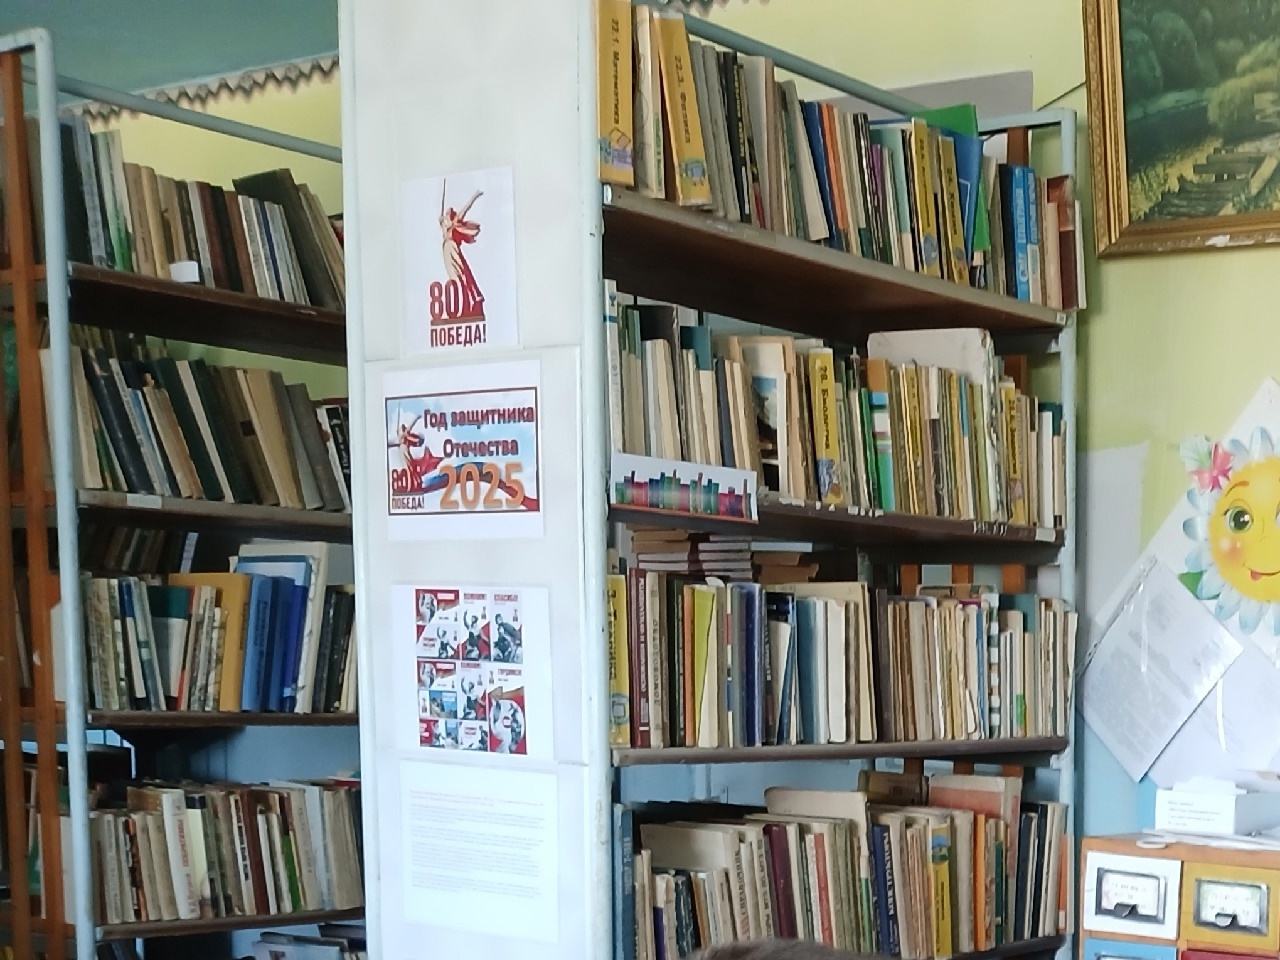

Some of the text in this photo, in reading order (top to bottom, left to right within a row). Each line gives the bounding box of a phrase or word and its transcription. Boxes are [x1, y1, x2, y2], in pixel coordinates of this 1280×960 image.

[611, 50, 622, 125] Математика
[679, 91, 692, 144] Физика
[948, 191, 958, 235] Химия
[430, 279, 460, 319] 80
[430, 324, 486, 348] ПОБЕДА!
[423, 406, 535, 431] Год защитника
[820, 388, 832, 450] Биология
[443, 438, 519, 459] Отечества
[391, 496, 425, 511] ПОБЕДА!
[439, 461, 526, 511] 2025
[651, 618, 662, 706] ДОМОВОДСТВО
[733, 849, 748, 917] СПРАВОЧНИК
[882, 831, 895, 916] КОНСТРУКТОРЫ
